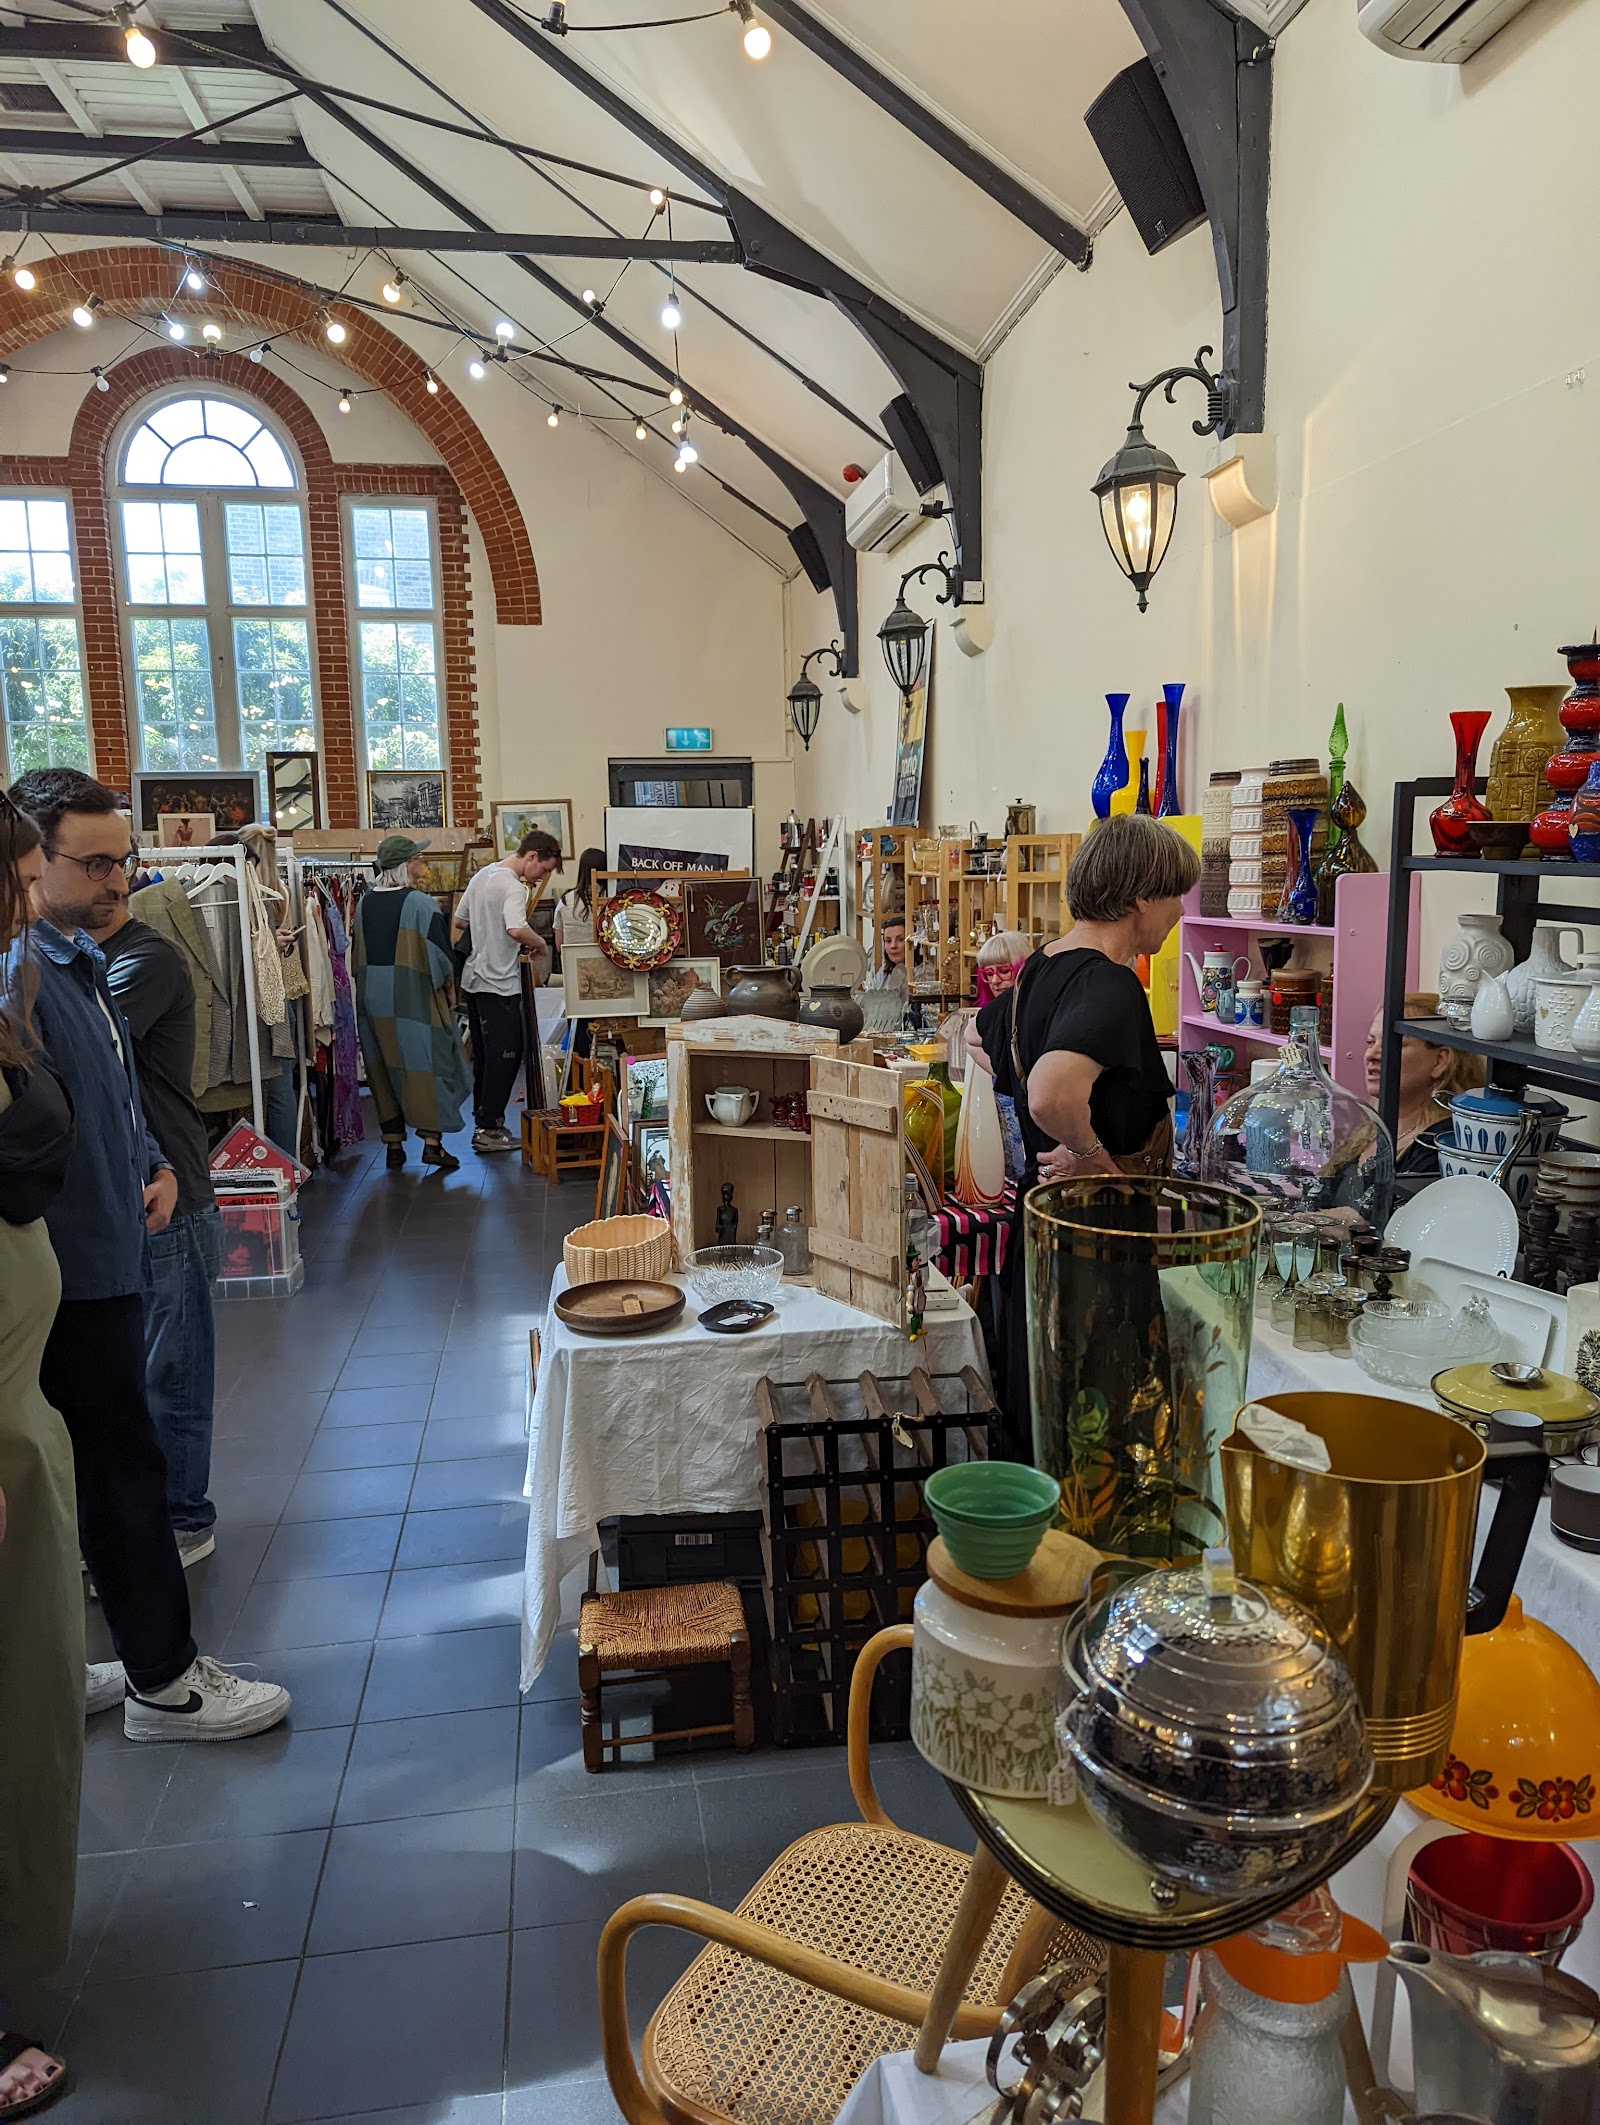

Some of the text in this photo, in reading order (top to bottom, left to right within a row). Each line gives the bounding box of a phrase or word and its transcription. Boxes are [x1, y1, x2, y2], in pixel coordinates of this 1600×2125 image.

[631, 857, 714, 871] BACK OFF MAN
